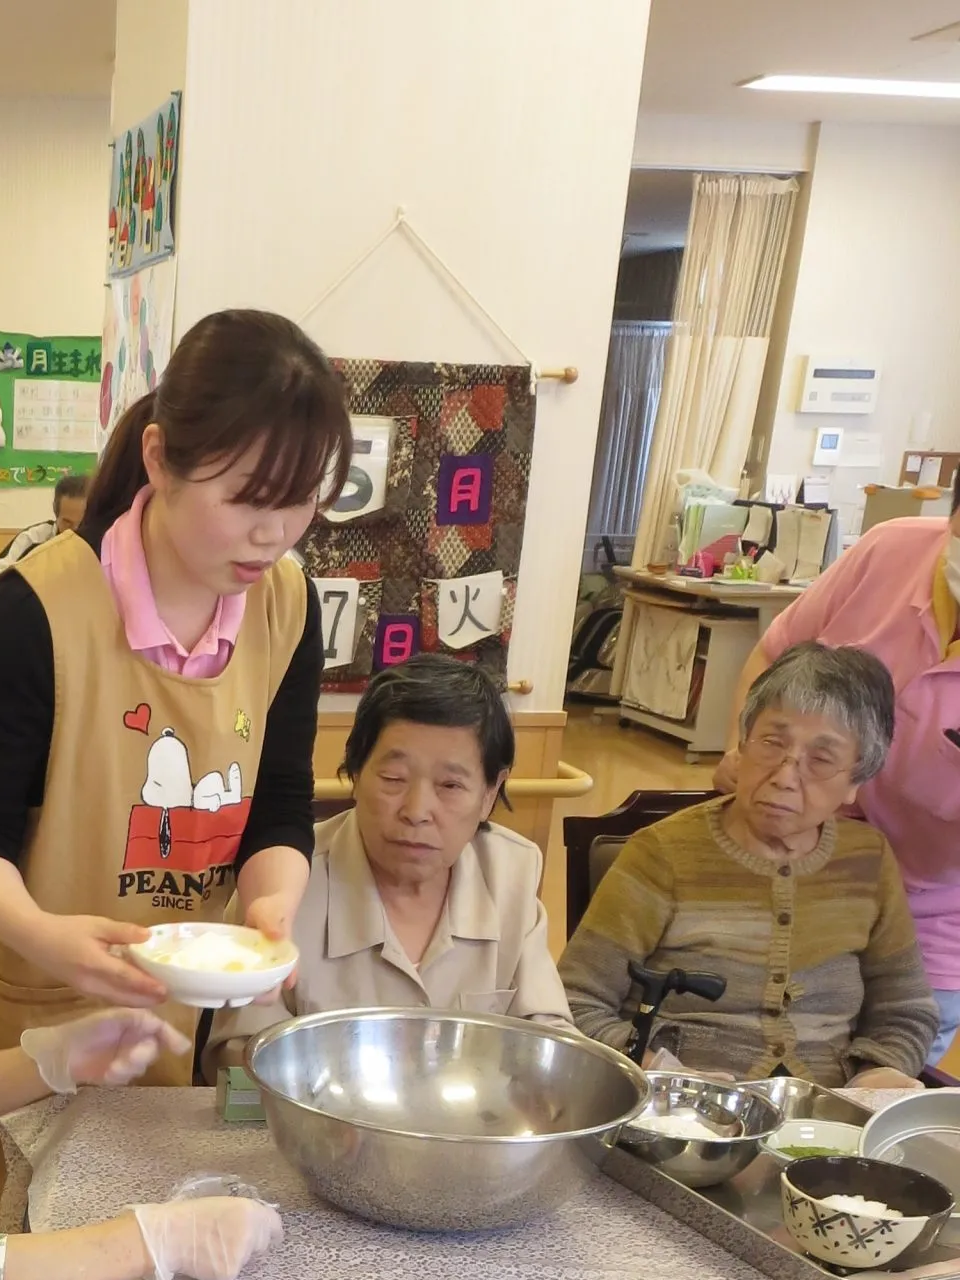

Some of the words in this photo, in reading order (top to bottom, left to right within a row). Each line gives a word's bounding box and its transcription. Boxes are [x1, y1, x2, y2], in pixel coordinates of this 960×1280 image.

[450, 468, 481, 513] 月
[323, 590, 349, 659] 7
[382, 623, 414, 664] 日
[448, 584, 492, 637] 火
[118, 863, 235, 898] PEANUT
[151, 895, 194, 911] SINCE
